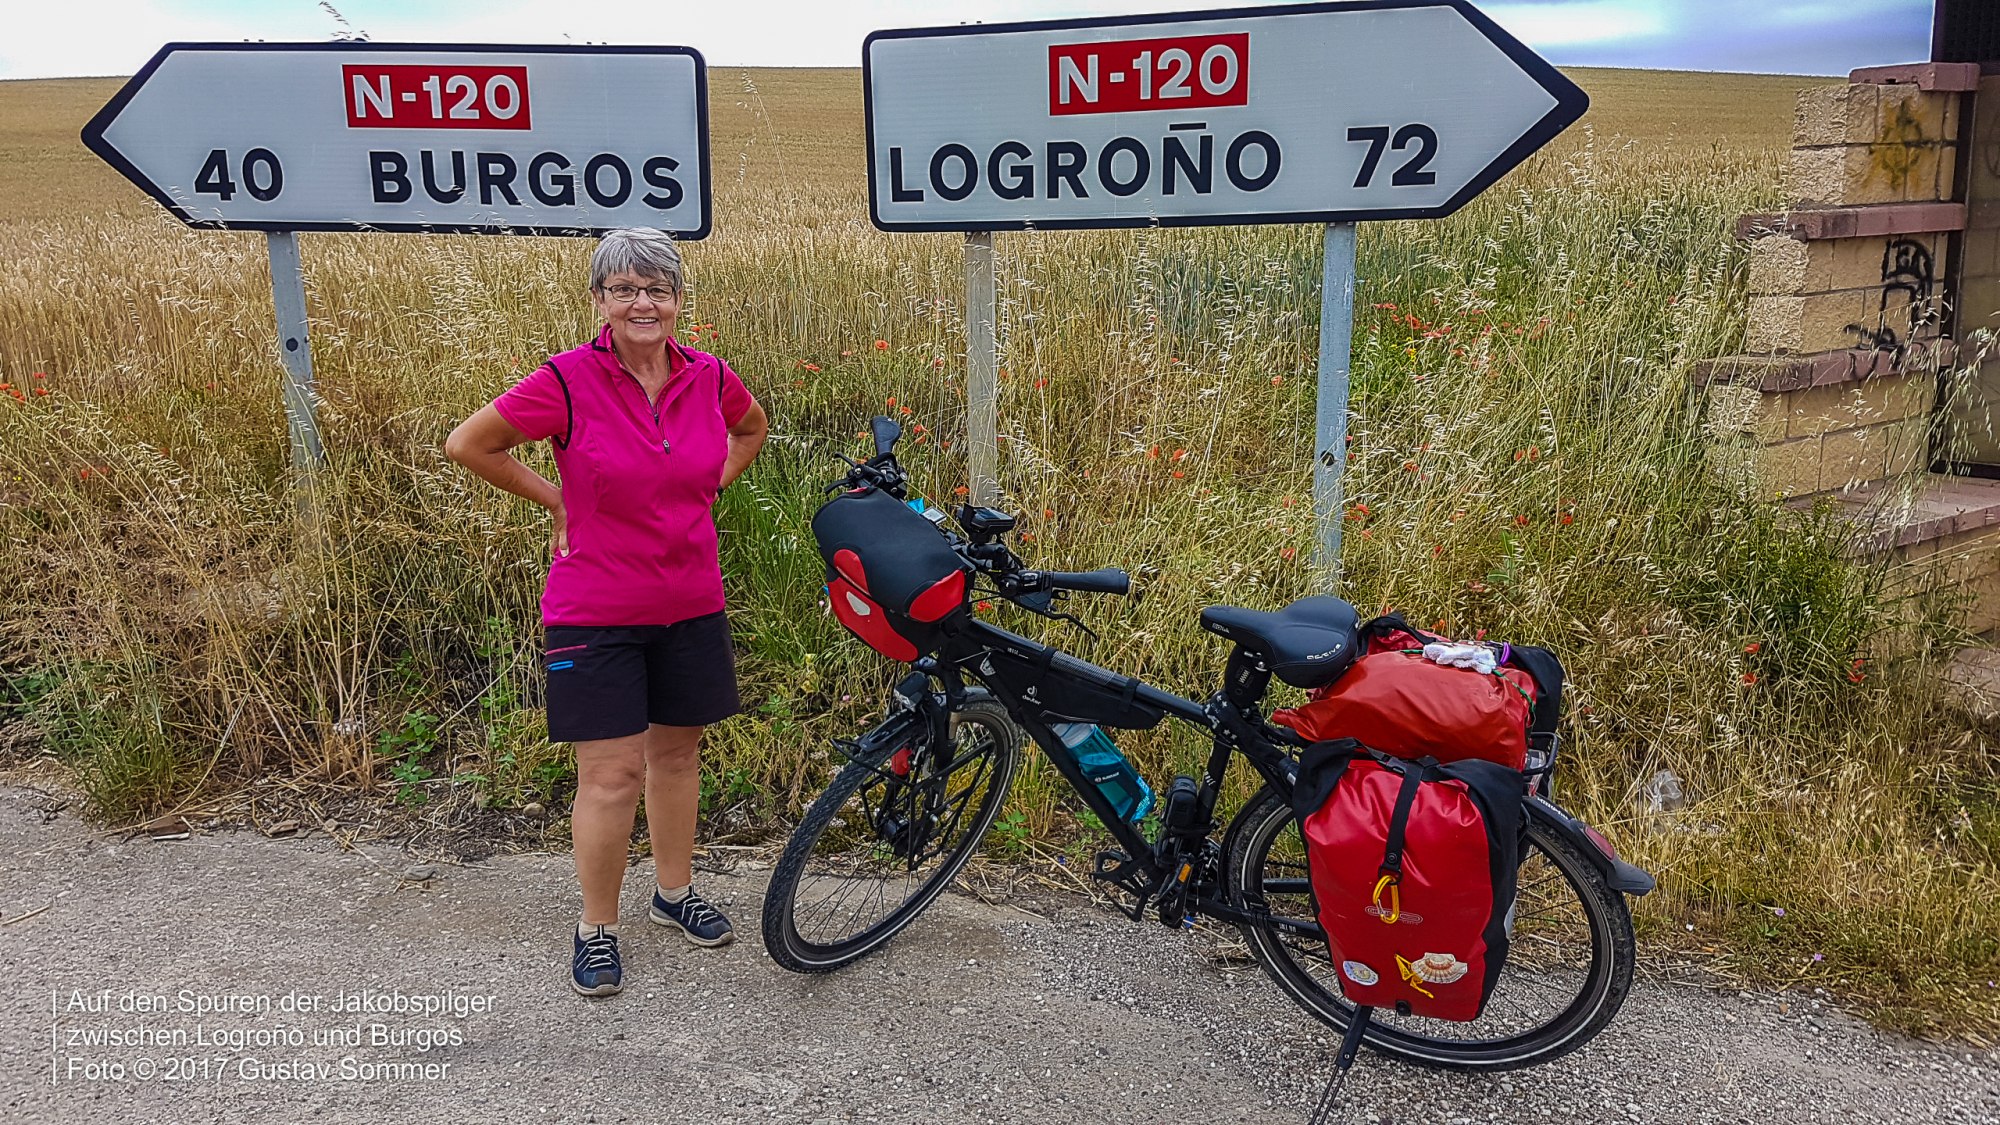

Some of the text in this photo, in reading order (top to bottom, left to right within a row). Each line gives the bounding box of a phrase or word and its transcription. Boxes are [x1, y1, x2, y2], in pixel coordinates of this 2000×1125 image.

[352, 74, 522, 121] N-120
[1057, 43, 1241, 106] N-120
[193, 148, 686, 211] 40 BURGOS
[889, 121, 1439, 204] LOGROÑO 72
